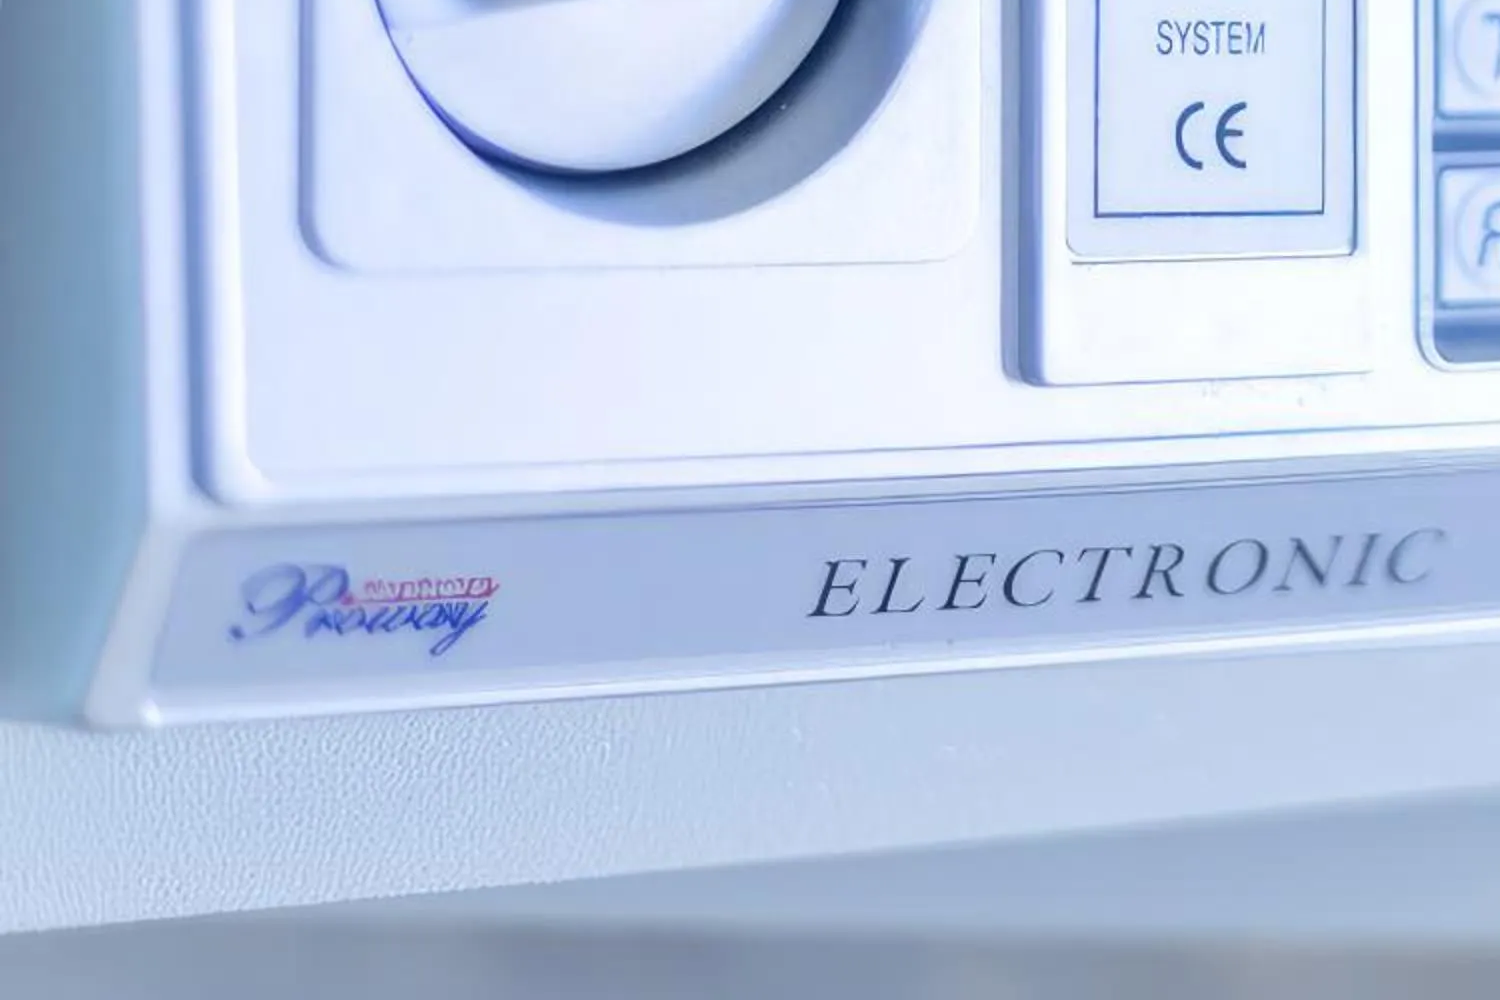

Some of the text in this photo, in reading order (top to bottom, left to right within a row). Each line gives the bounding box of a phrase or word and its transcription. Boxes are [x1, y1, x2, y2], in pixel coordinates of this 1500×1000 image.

[1156, 19, 1265, 55] SYSTEM
[1175, 101, 1247, 170] CE
[806, 527, 1446, 618] ELECTRONIC
